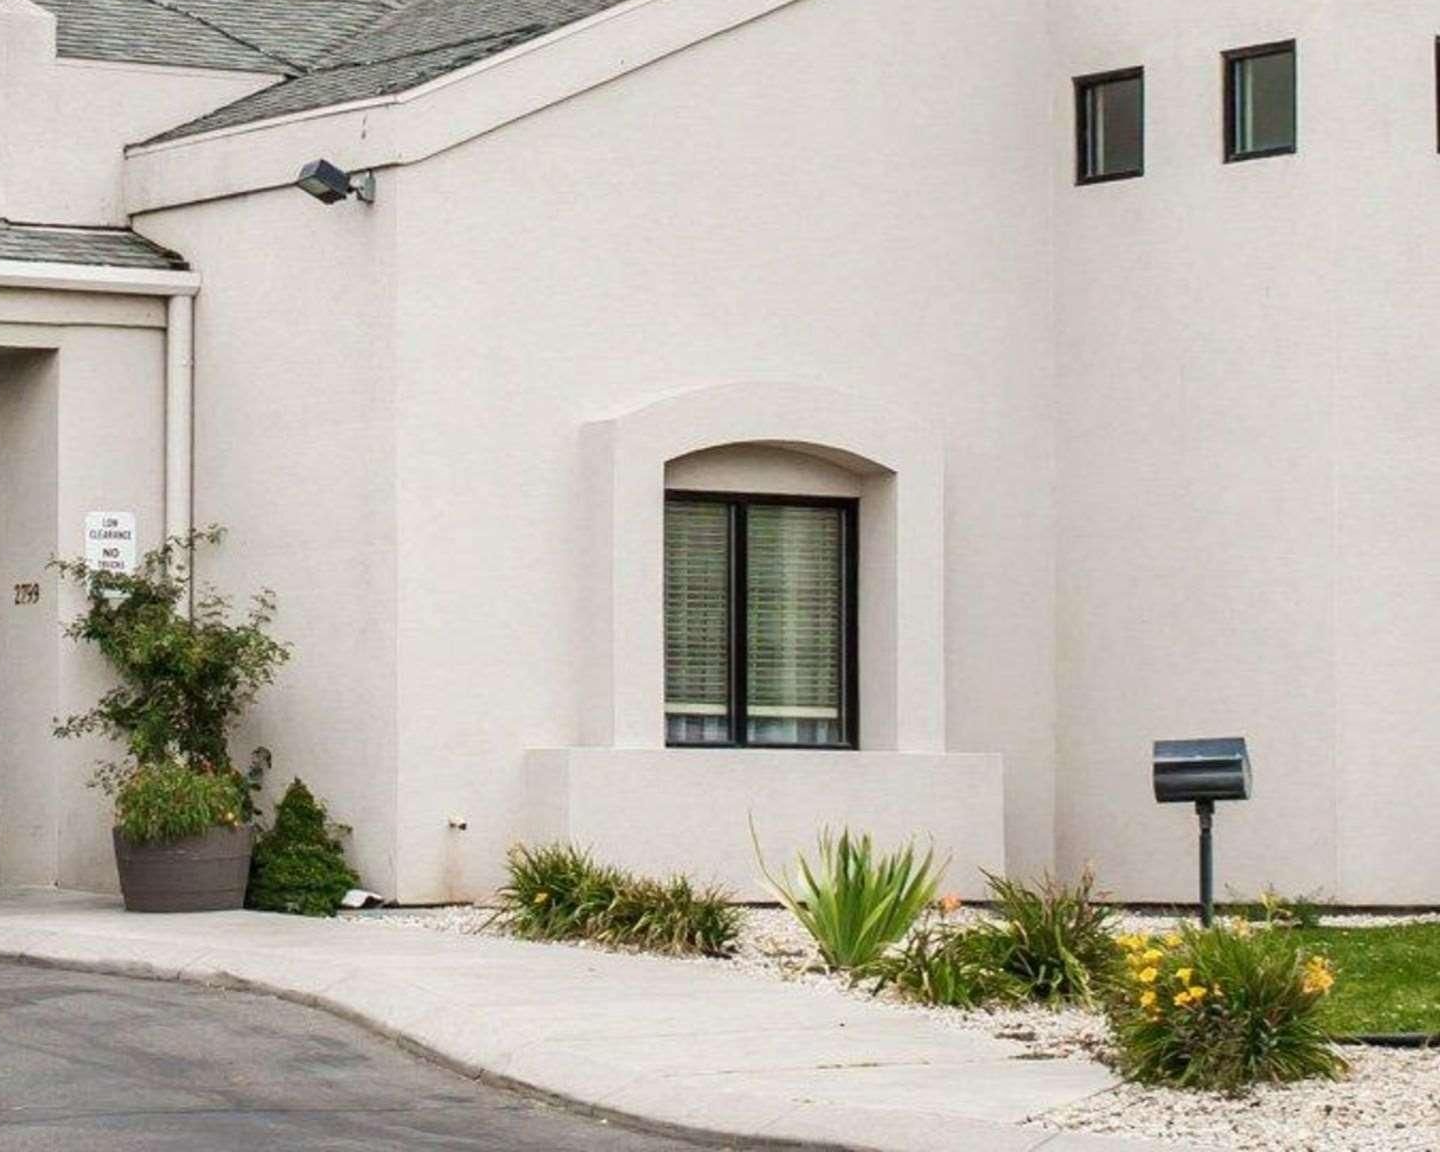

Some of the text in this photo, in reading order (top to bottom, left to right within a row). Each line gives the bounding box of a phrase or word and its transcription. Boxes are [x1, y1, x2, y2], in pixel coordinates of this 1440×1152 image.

[102, 517, 118, 528] LOW
[89, 529, 132, 540] CLEARANCE
[102, 548, 119, 559] NO
